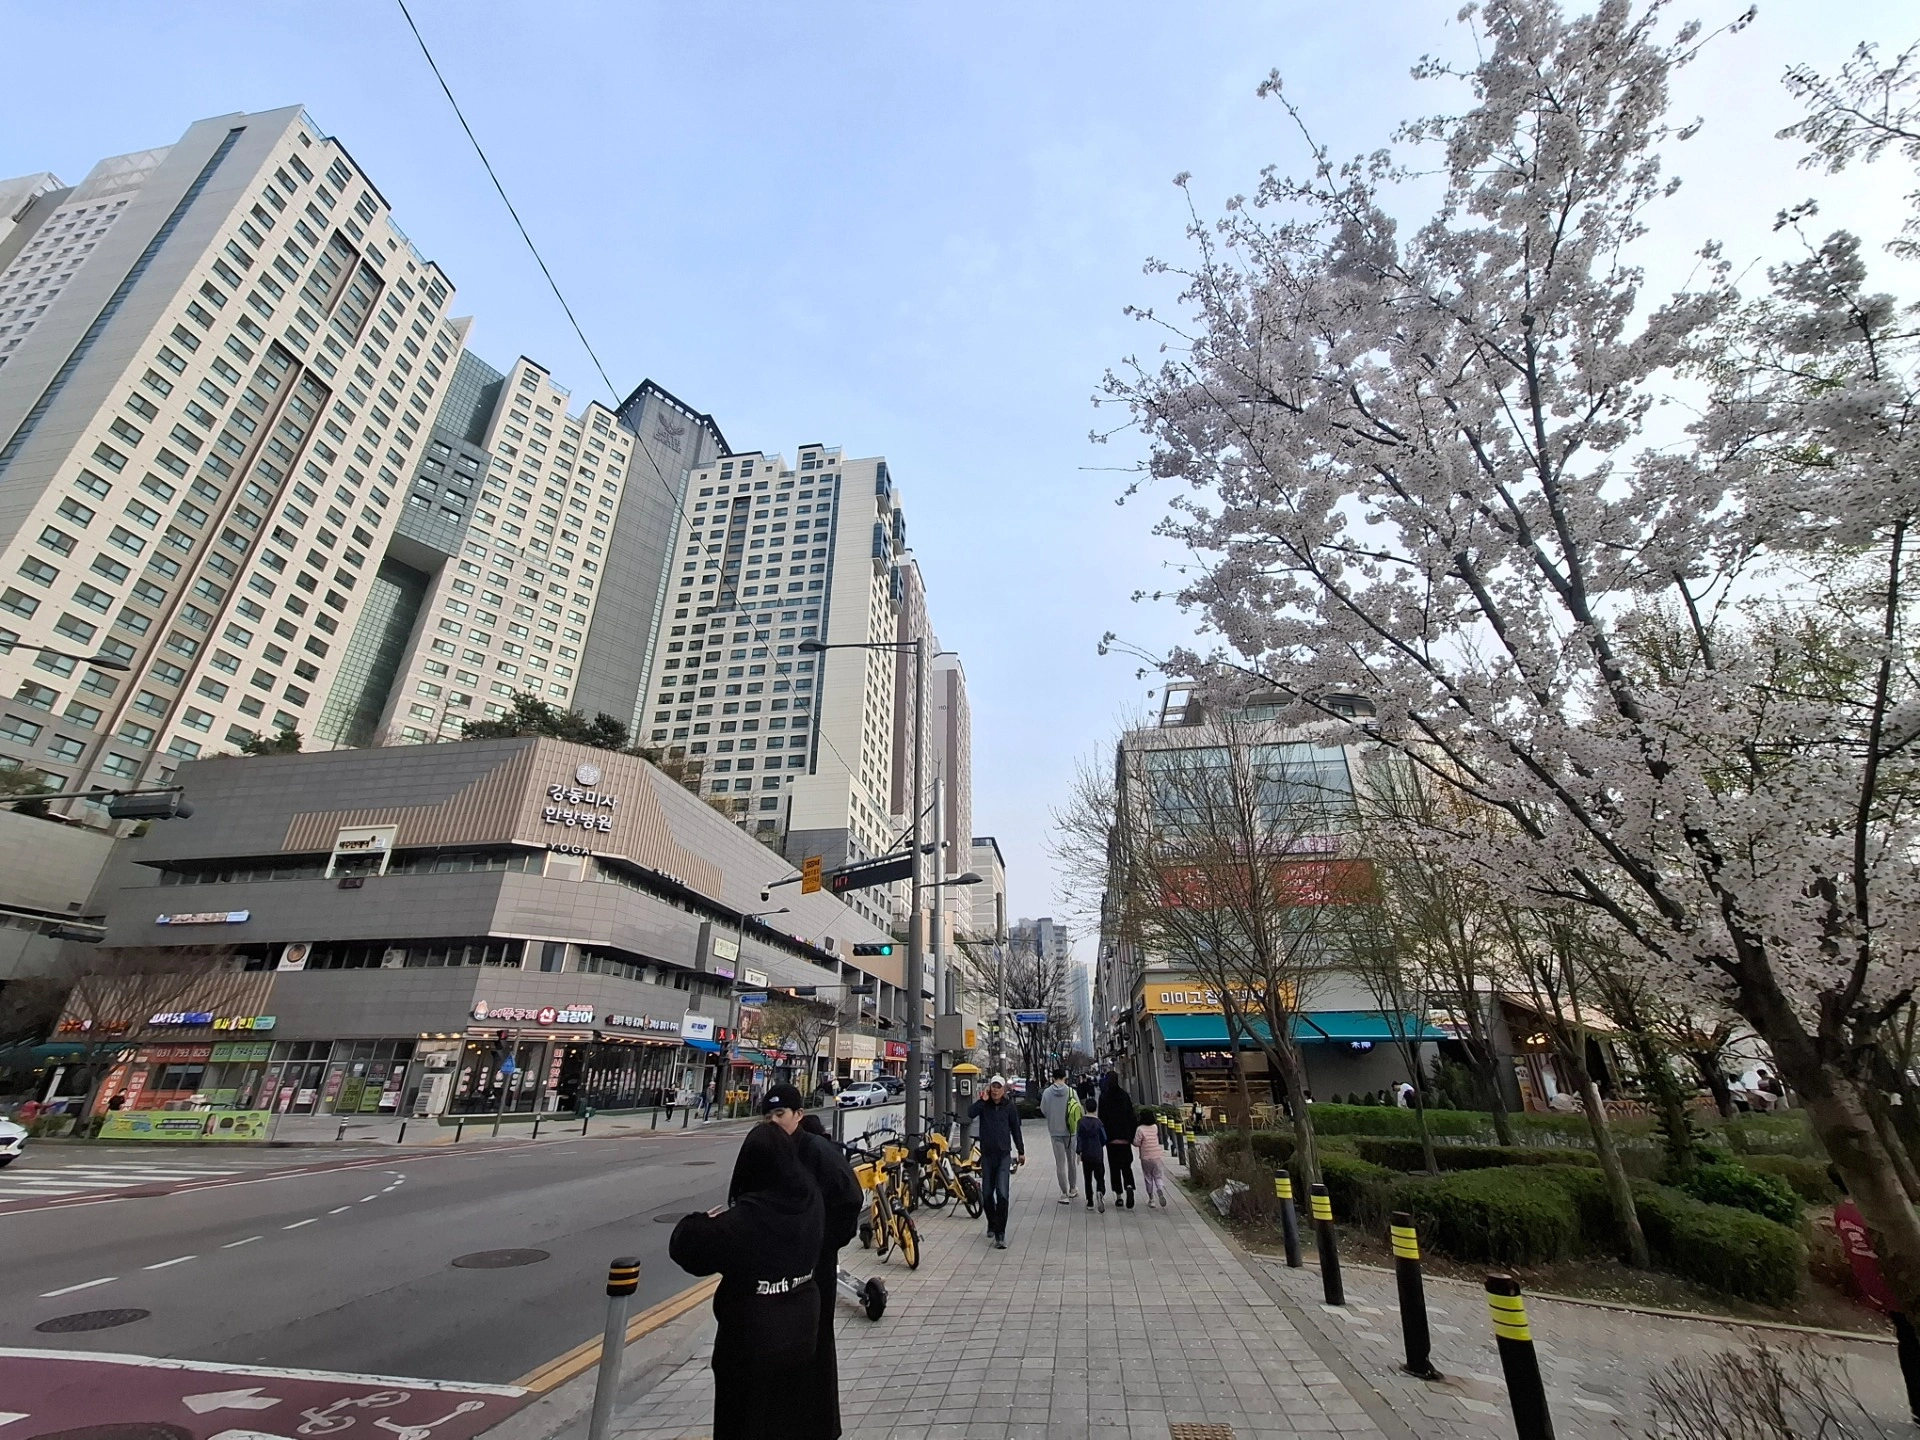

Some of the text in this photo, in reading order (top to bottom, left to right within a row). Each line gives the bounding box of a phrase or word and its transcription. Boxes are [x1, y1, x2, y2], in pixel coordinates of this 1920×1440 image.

[548, 783, 618, 810] 강동미사
[544, 806, 614, 831] 한방병원
[550, 842, 591, 856] YOGA
[1161, 990, 1203, 1005] 미미고
[488, 1007, 538, 1021] 어쭈구리
[539, 1008, 556, 1023] 산
[156, 1048, 171, 1058] 031
[174, 1048, 189, 1058] 793
[755, 1277, 789, 1295] Dark
